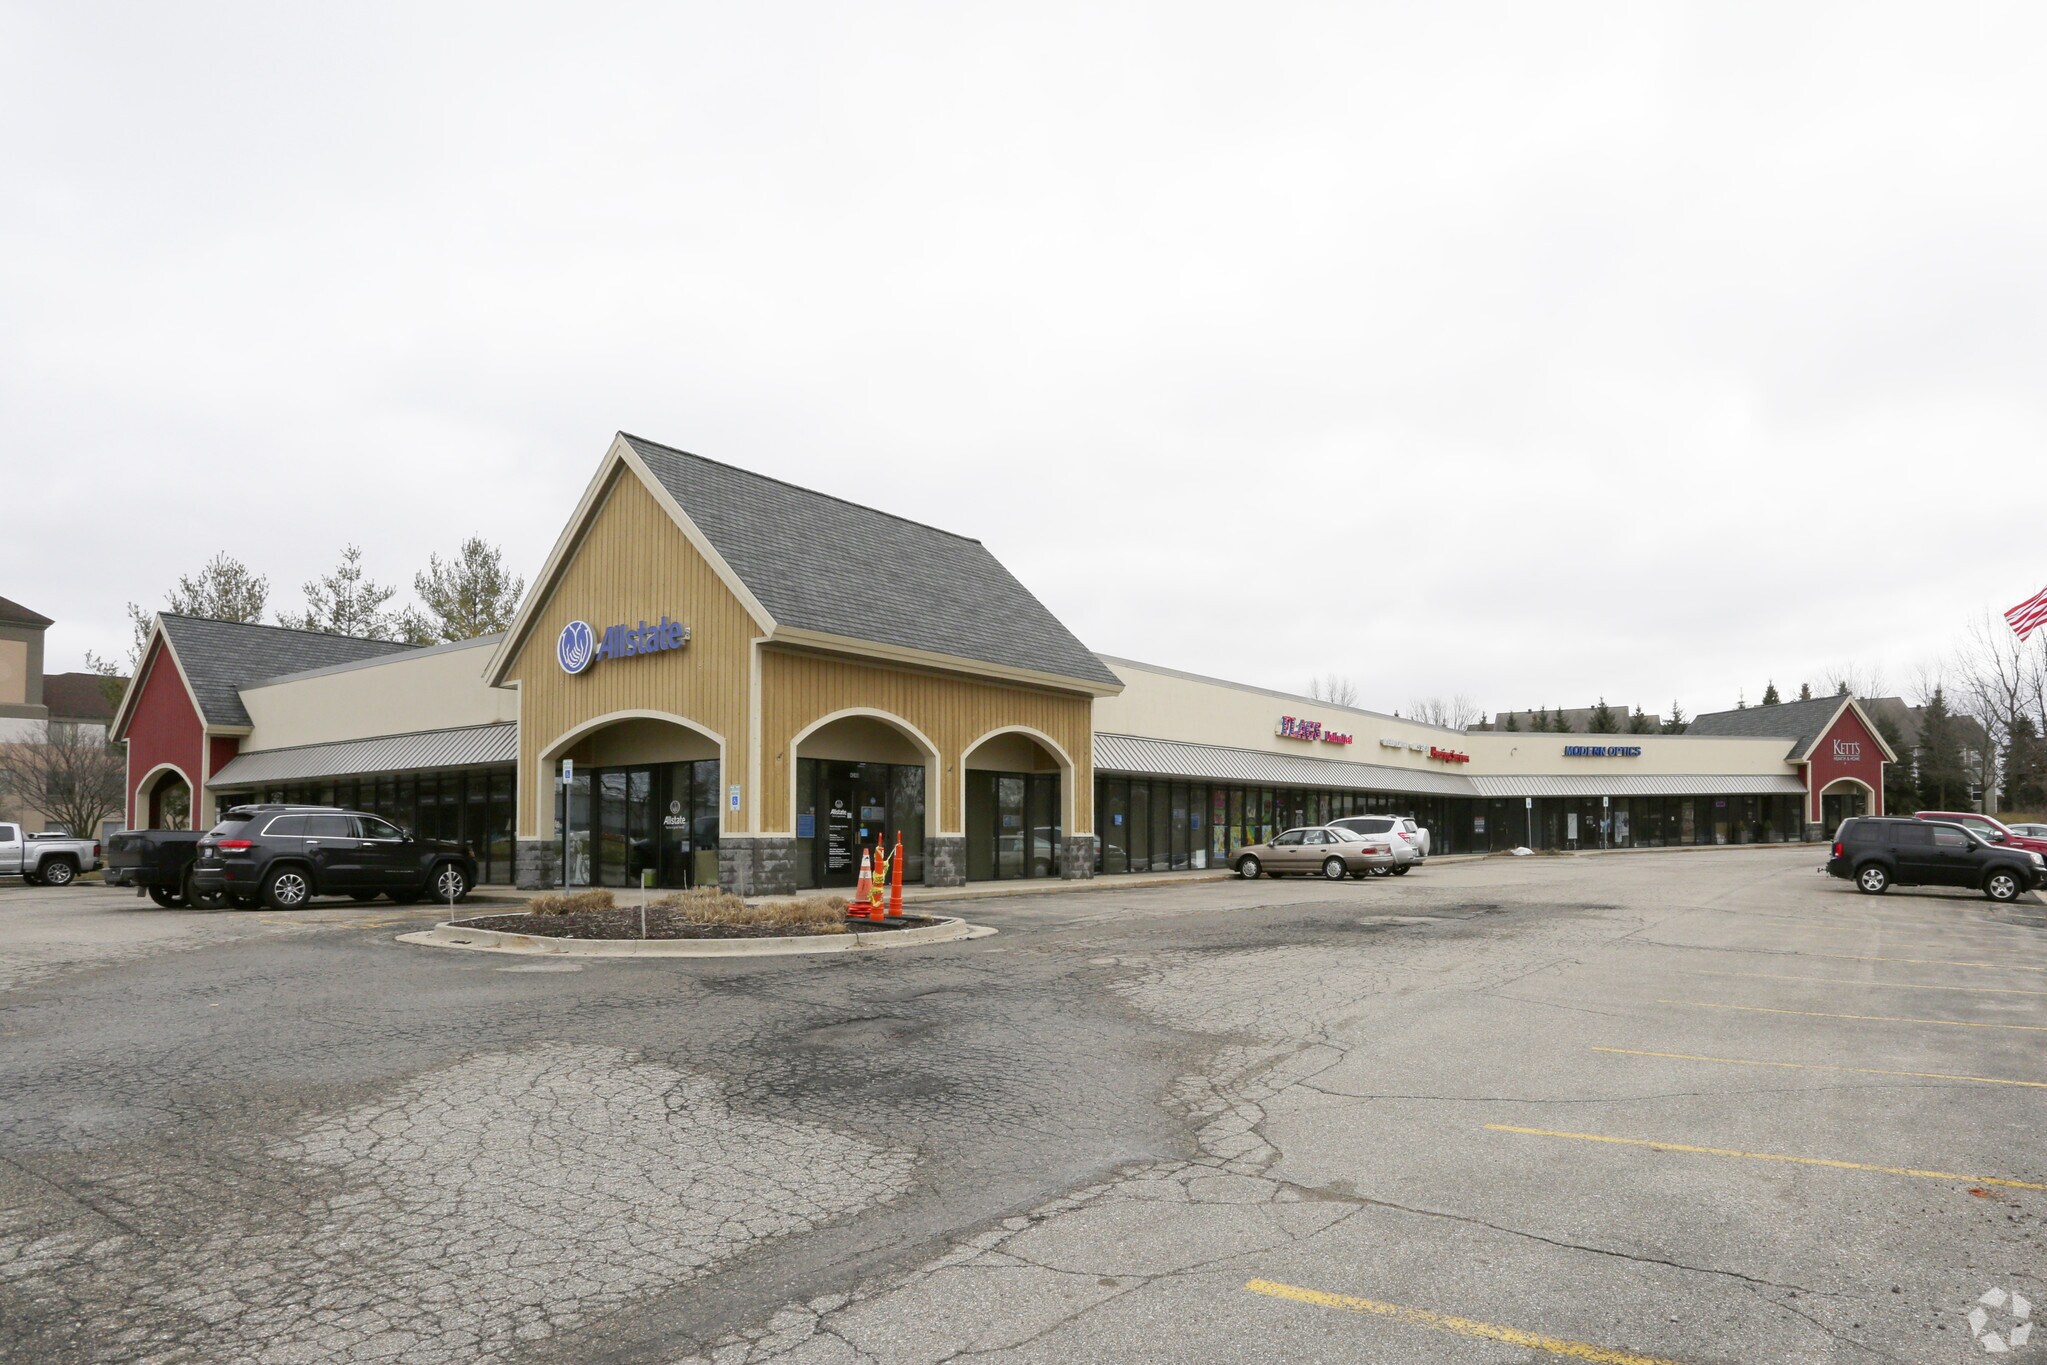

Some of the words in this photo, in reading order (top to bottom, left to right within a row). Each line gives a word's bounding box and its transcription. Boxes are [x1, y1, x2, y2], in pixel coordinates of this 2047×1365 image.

[596, 616, 684, 661] Allstate
[1281, 716, 1321, 740] FLAGS
[1565, 746, 1606, 757] MODERN
[1607, 746, 1641, 757] OPTICS
[663, 816, 686, 825] Allstate
